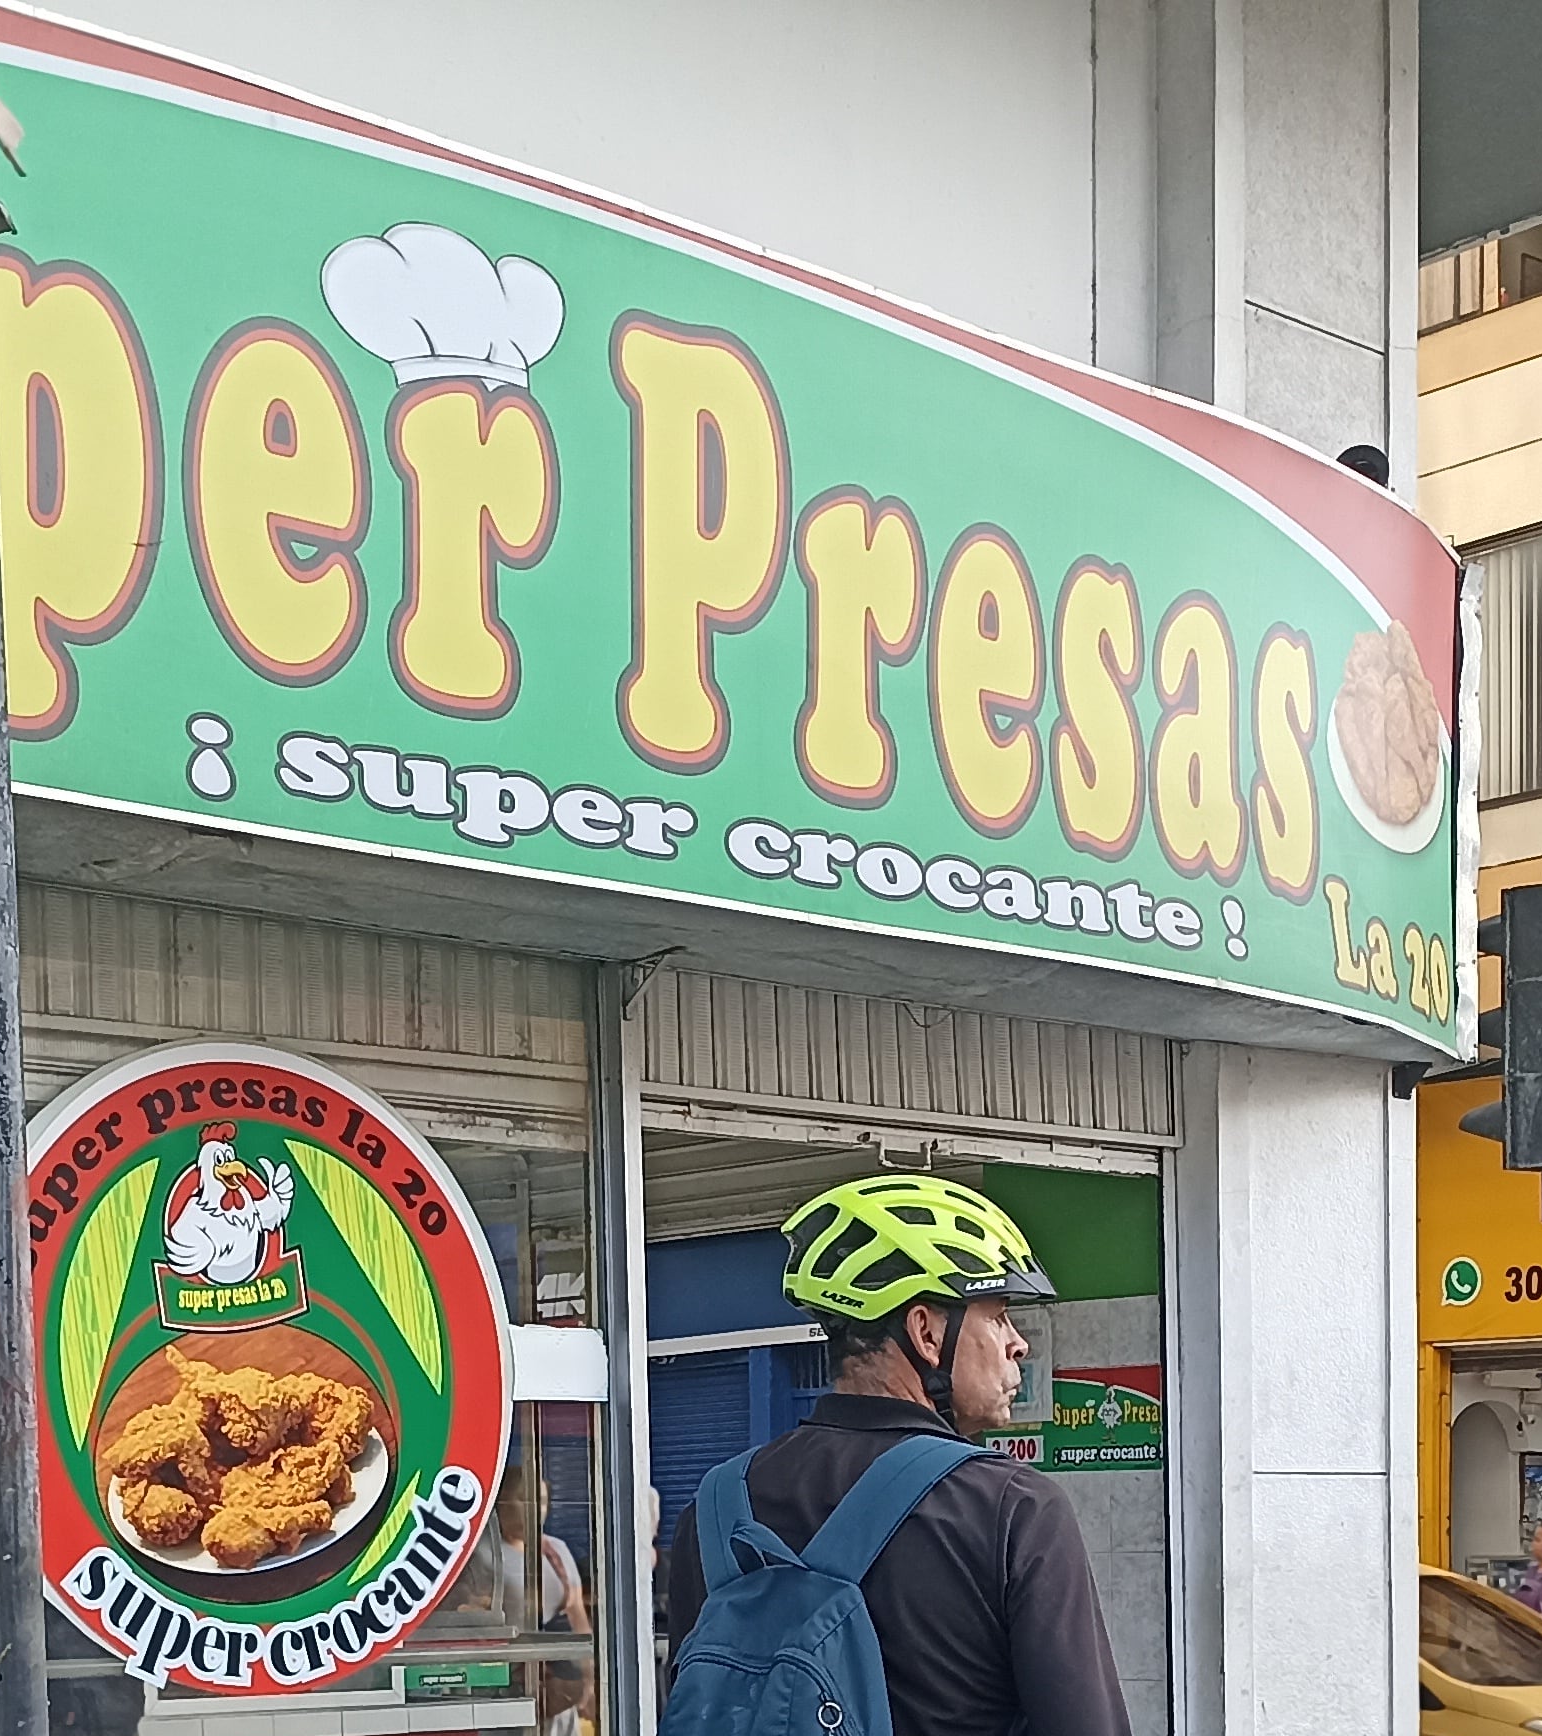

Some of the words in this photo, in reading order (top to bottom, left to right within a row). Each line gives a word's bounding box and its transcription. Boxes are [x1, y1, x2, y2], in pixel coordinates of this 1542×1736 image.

[610, 311, 1320, 901] Presas
[278, 730, 698, 857] super
[726, 815, 1204, 953] crocante
[1326, 876, 1397, 986] La
[1402, 922, 1449, 1027] 20
[28, 1110, 125, 1269] uper
[136, 1076, 328, 1135] presas
[338, 1107, 387, 1169] la
[391, 1167, 449, 1236] 20
[178, 1289, 215, 1314] super
[216, 1285, 258, 1313] presas
[820, 1290, 865, 1309] LAZER
[964, 1278, 1006, 1292] LAZER
[1053, 1401, 1096, 1430] Super
[1060, 1448, 1098, 1465] super
[1099, 1444, 1158, 1461] crocante
[72, 1552, 261, 1687] super
[269, 1469, 481, 1665] crocante
